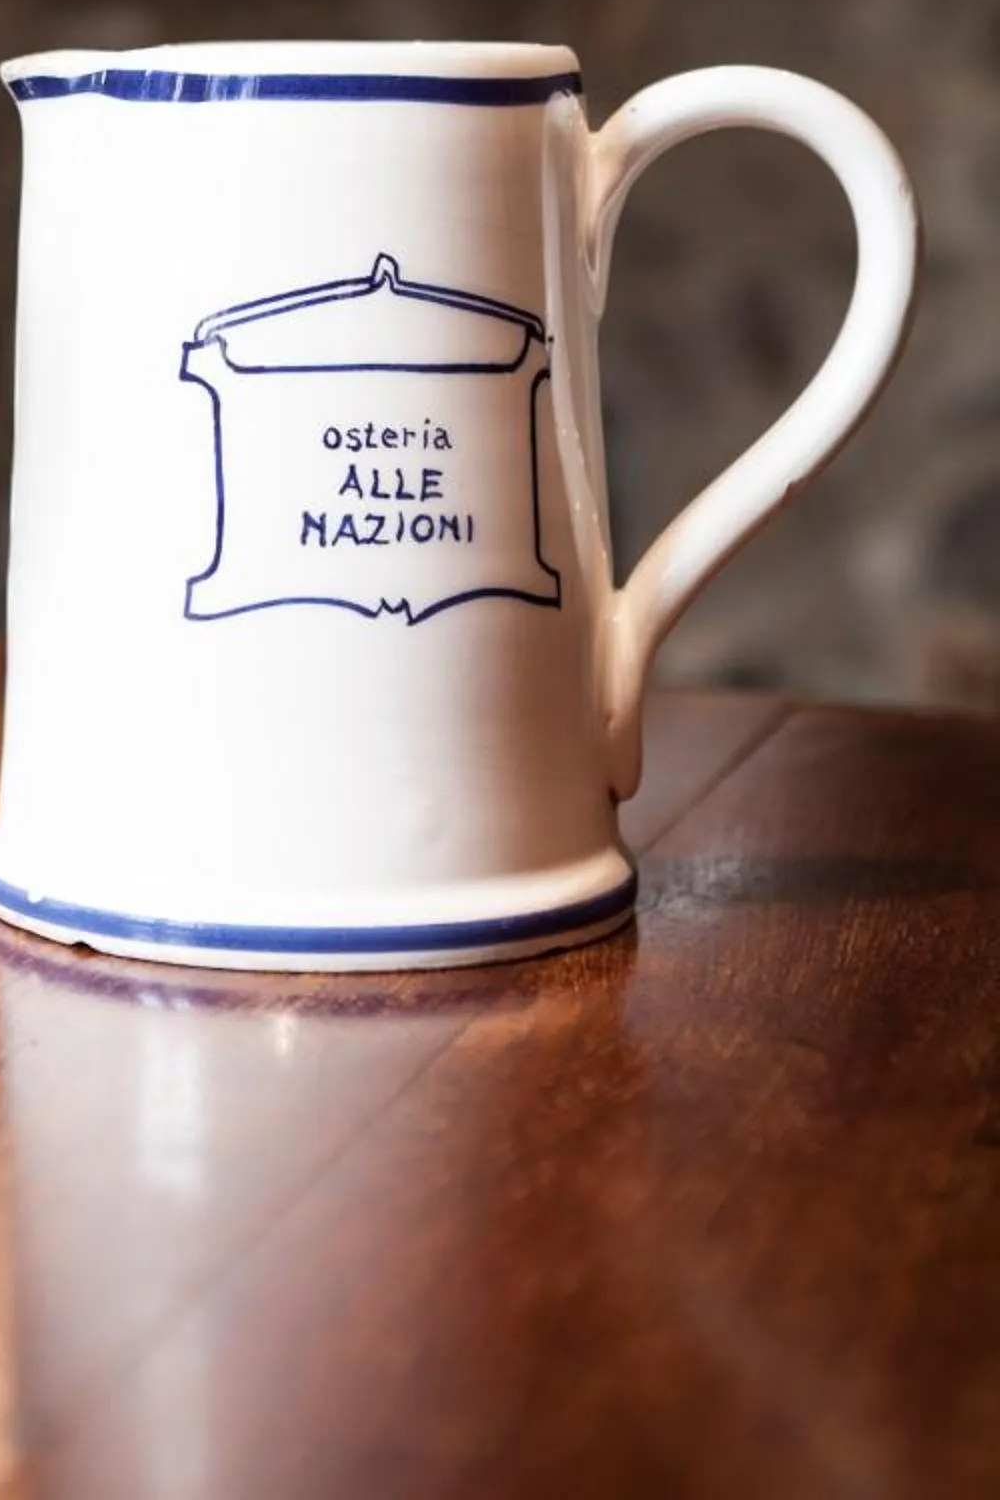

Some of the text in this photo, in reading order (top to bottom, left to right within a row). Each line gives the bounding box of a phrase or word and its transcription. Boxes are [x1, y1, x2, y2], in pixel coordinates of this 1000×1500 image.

[321, 417, 454, 453] osteria
[337, 463, 445, 503] ALLE
[299, 510, 476, 548] NAZIONI
